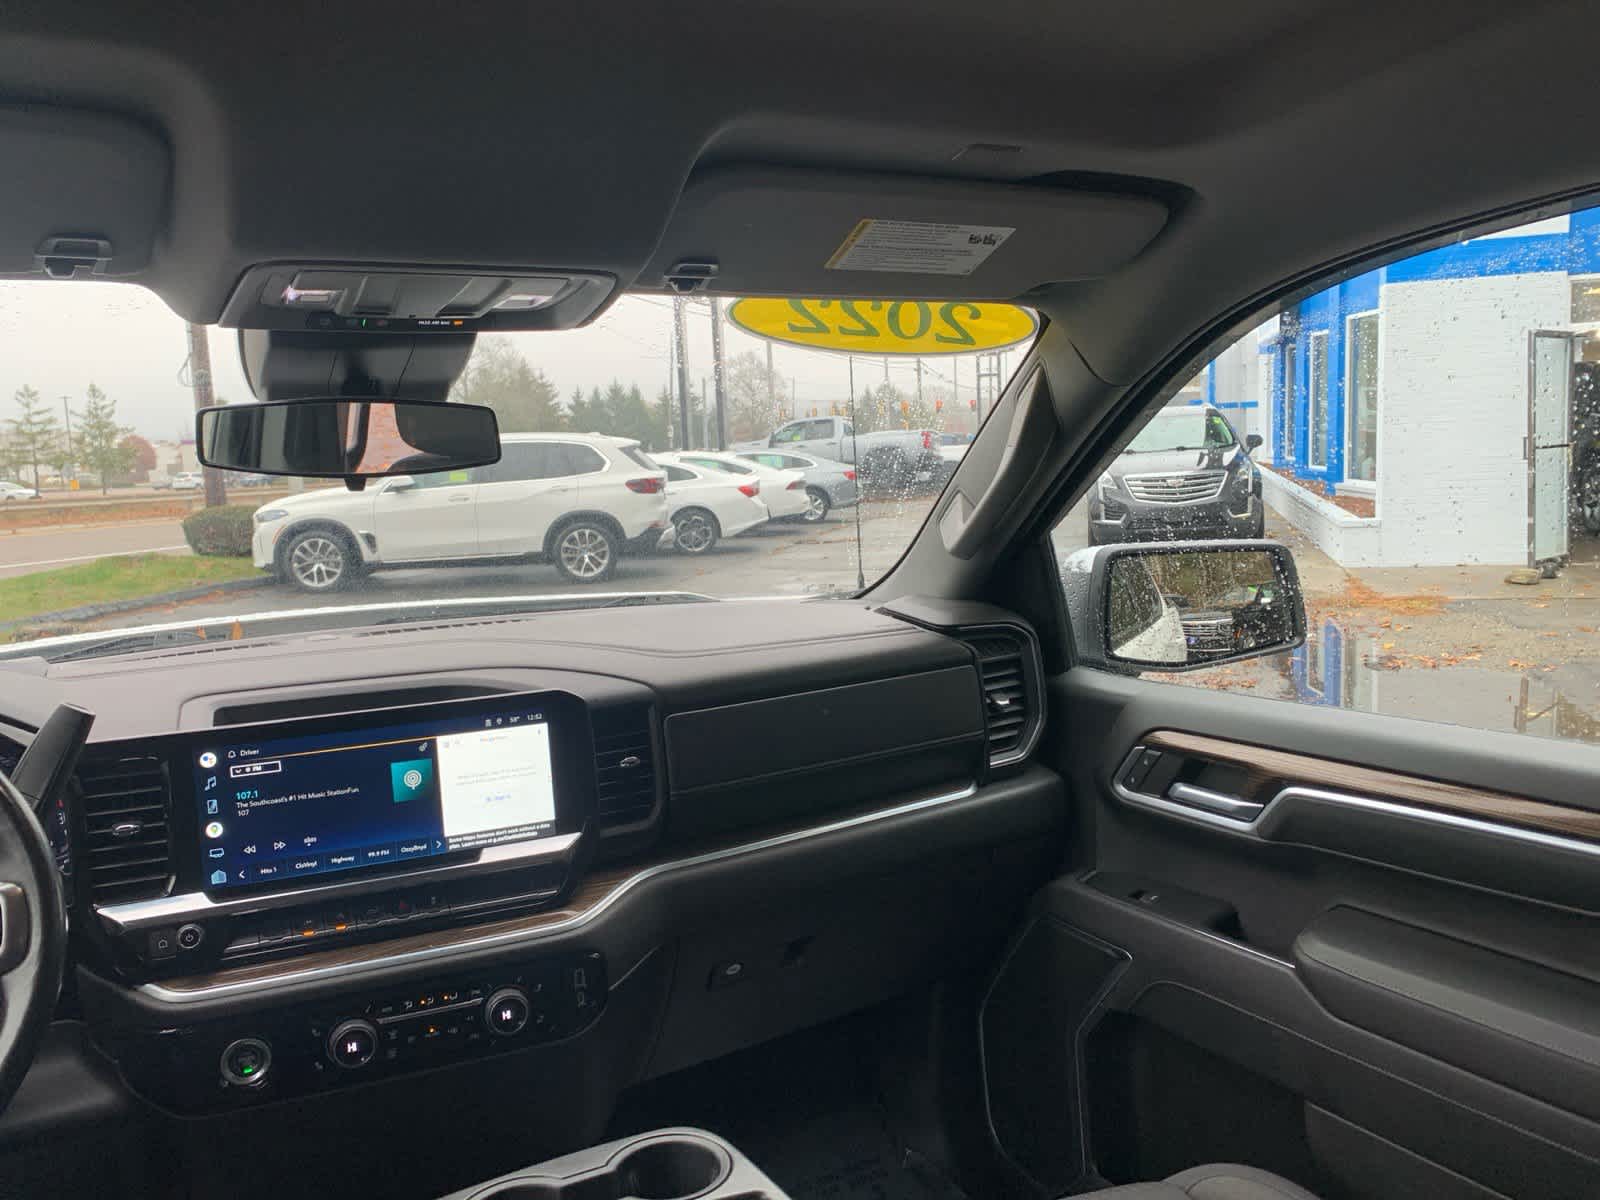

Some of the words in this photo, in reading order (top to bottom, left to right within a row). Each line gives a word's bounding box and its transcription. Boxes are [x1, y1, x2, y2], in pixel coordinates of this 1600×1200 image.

[240, 749, 260, 757] Driver
[236, 790, 258, 800] 107.1
[236, 801, 249, 809] The
[297, 793, 307, 801] Hit
[308, 791, 326, 799] Music
[237, 808, 249, 817] 107
[331, 855, 355, 865] Highway
